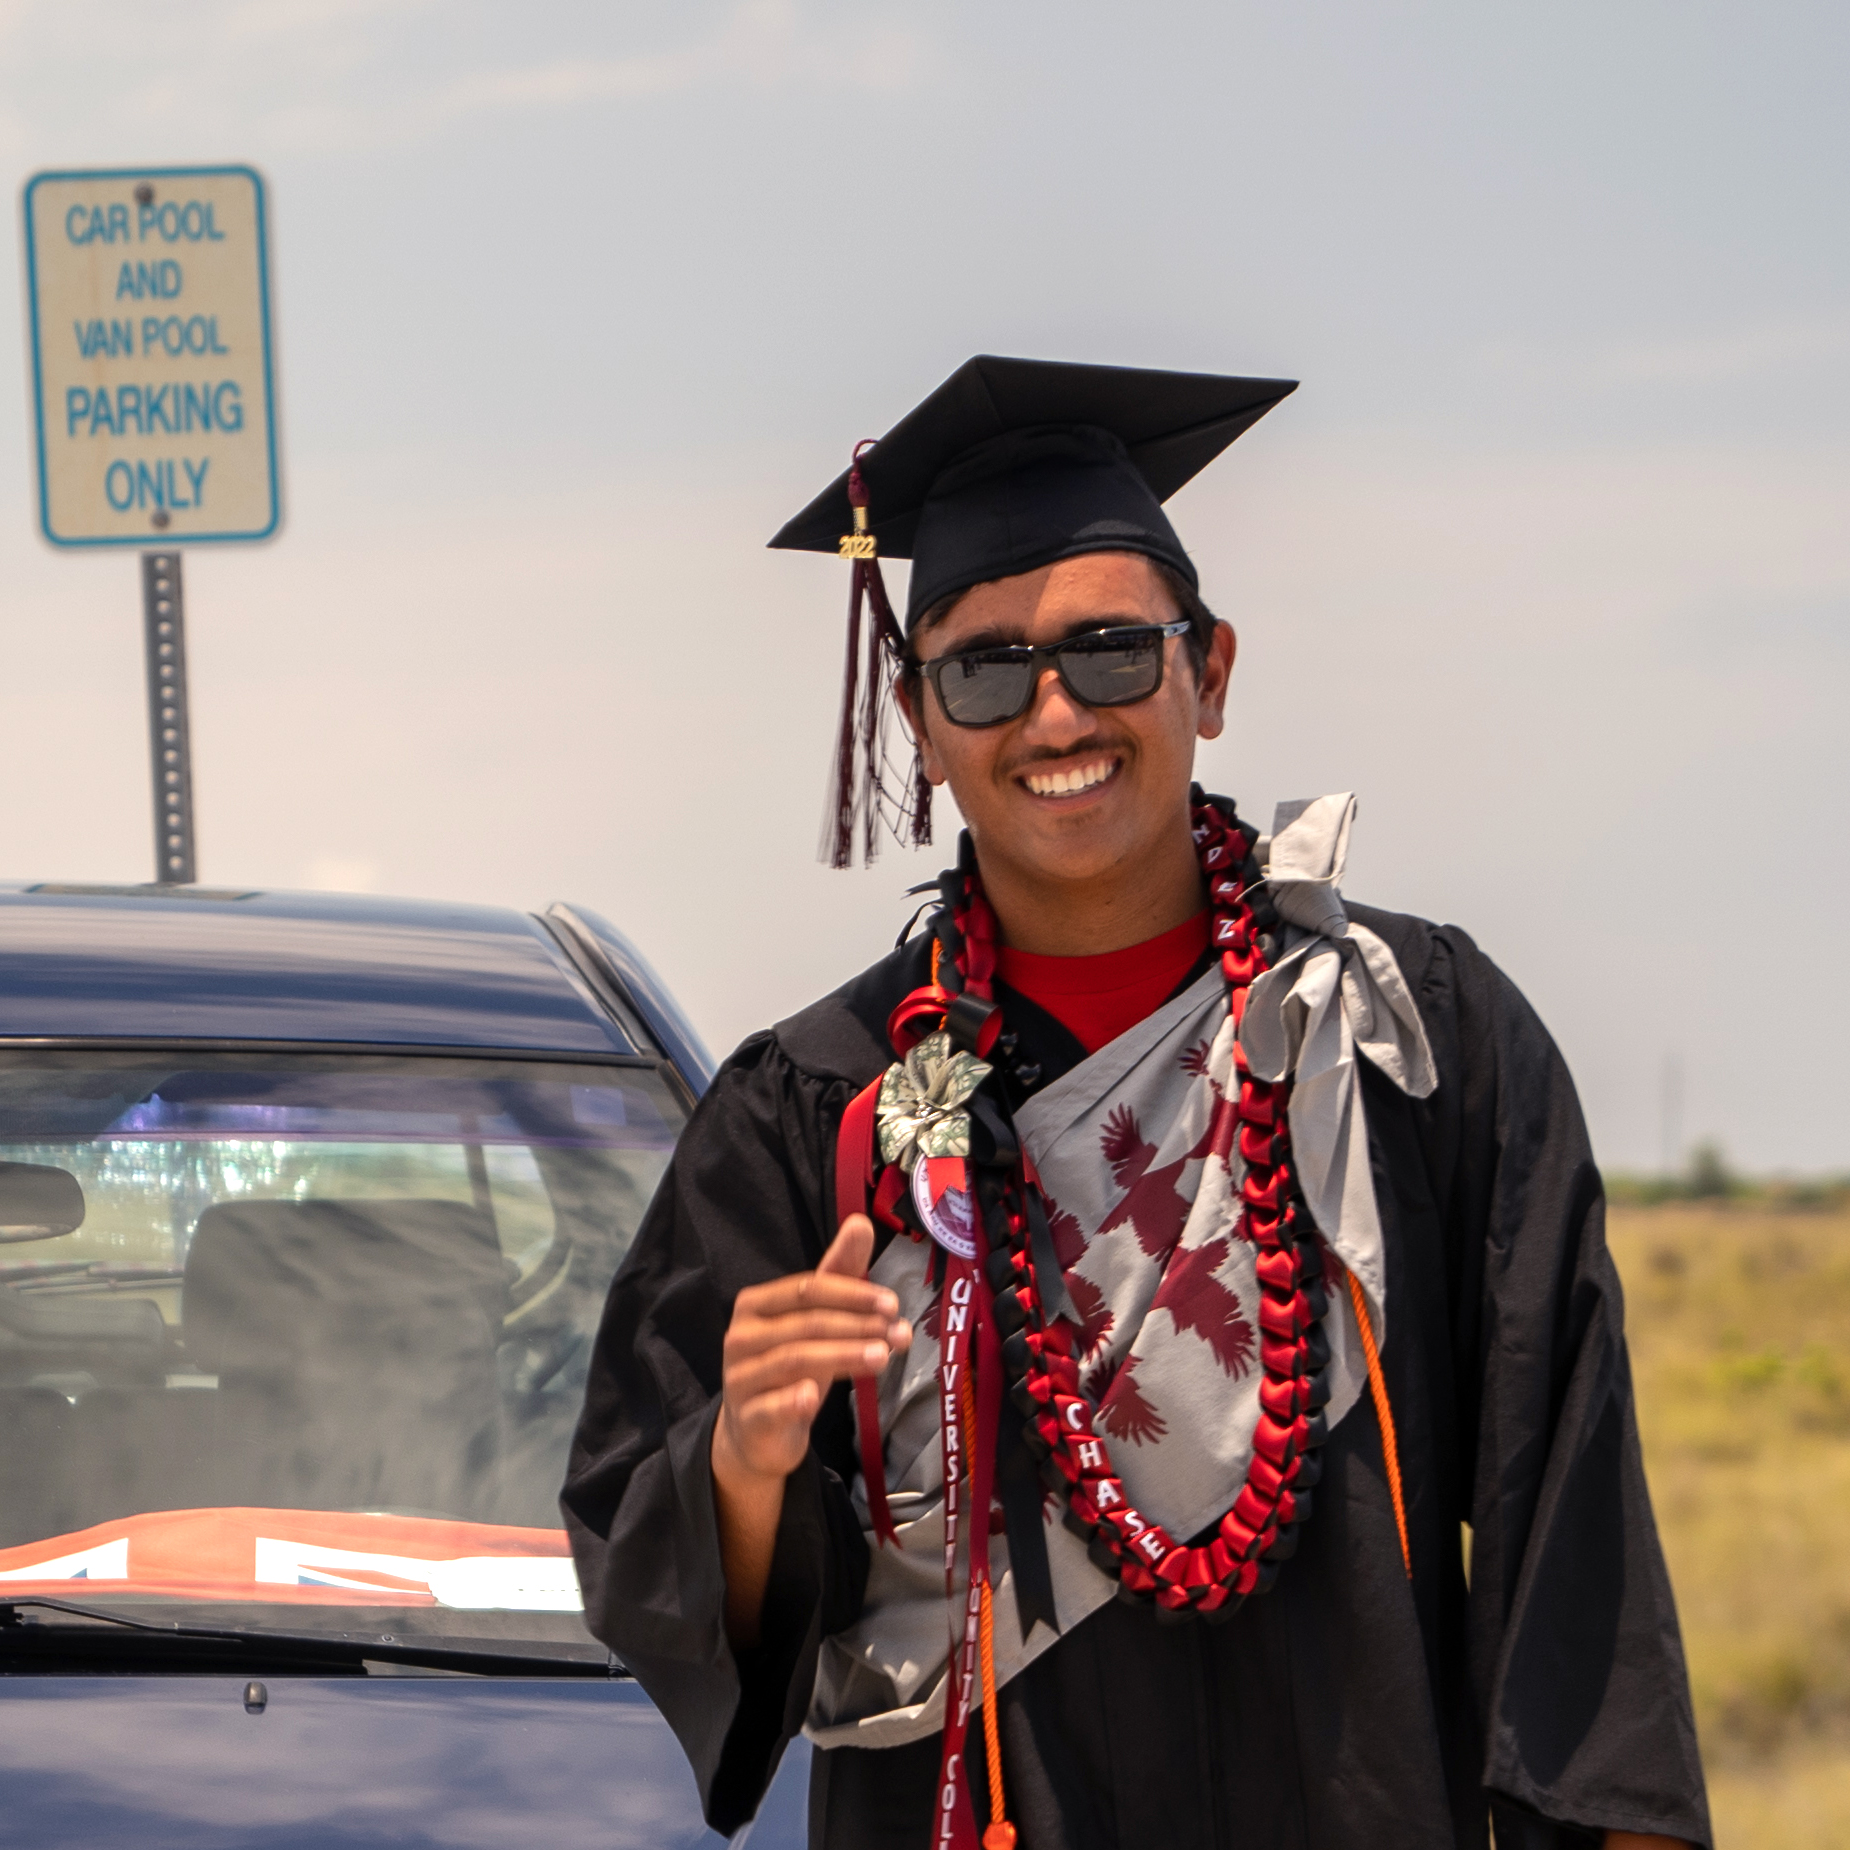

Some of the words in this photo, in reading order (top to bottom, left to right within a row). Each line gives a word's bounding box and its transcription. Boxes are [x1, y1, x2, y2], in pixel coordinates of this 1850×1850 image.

[65, 203, 130, 246] CAR
[138, 200, 226, 243] POOL
[115, 258, 184, 302] AND
[73, 318, 134, 360] VAN
[141, 314, 229, 357] POOL
[65, 380, 245, 438] PARKING
[104, 457, 211, 513] ONLY
[839, 535, 878, 559] 2022
[1066, 1401, 1166, 1561] CHASE
